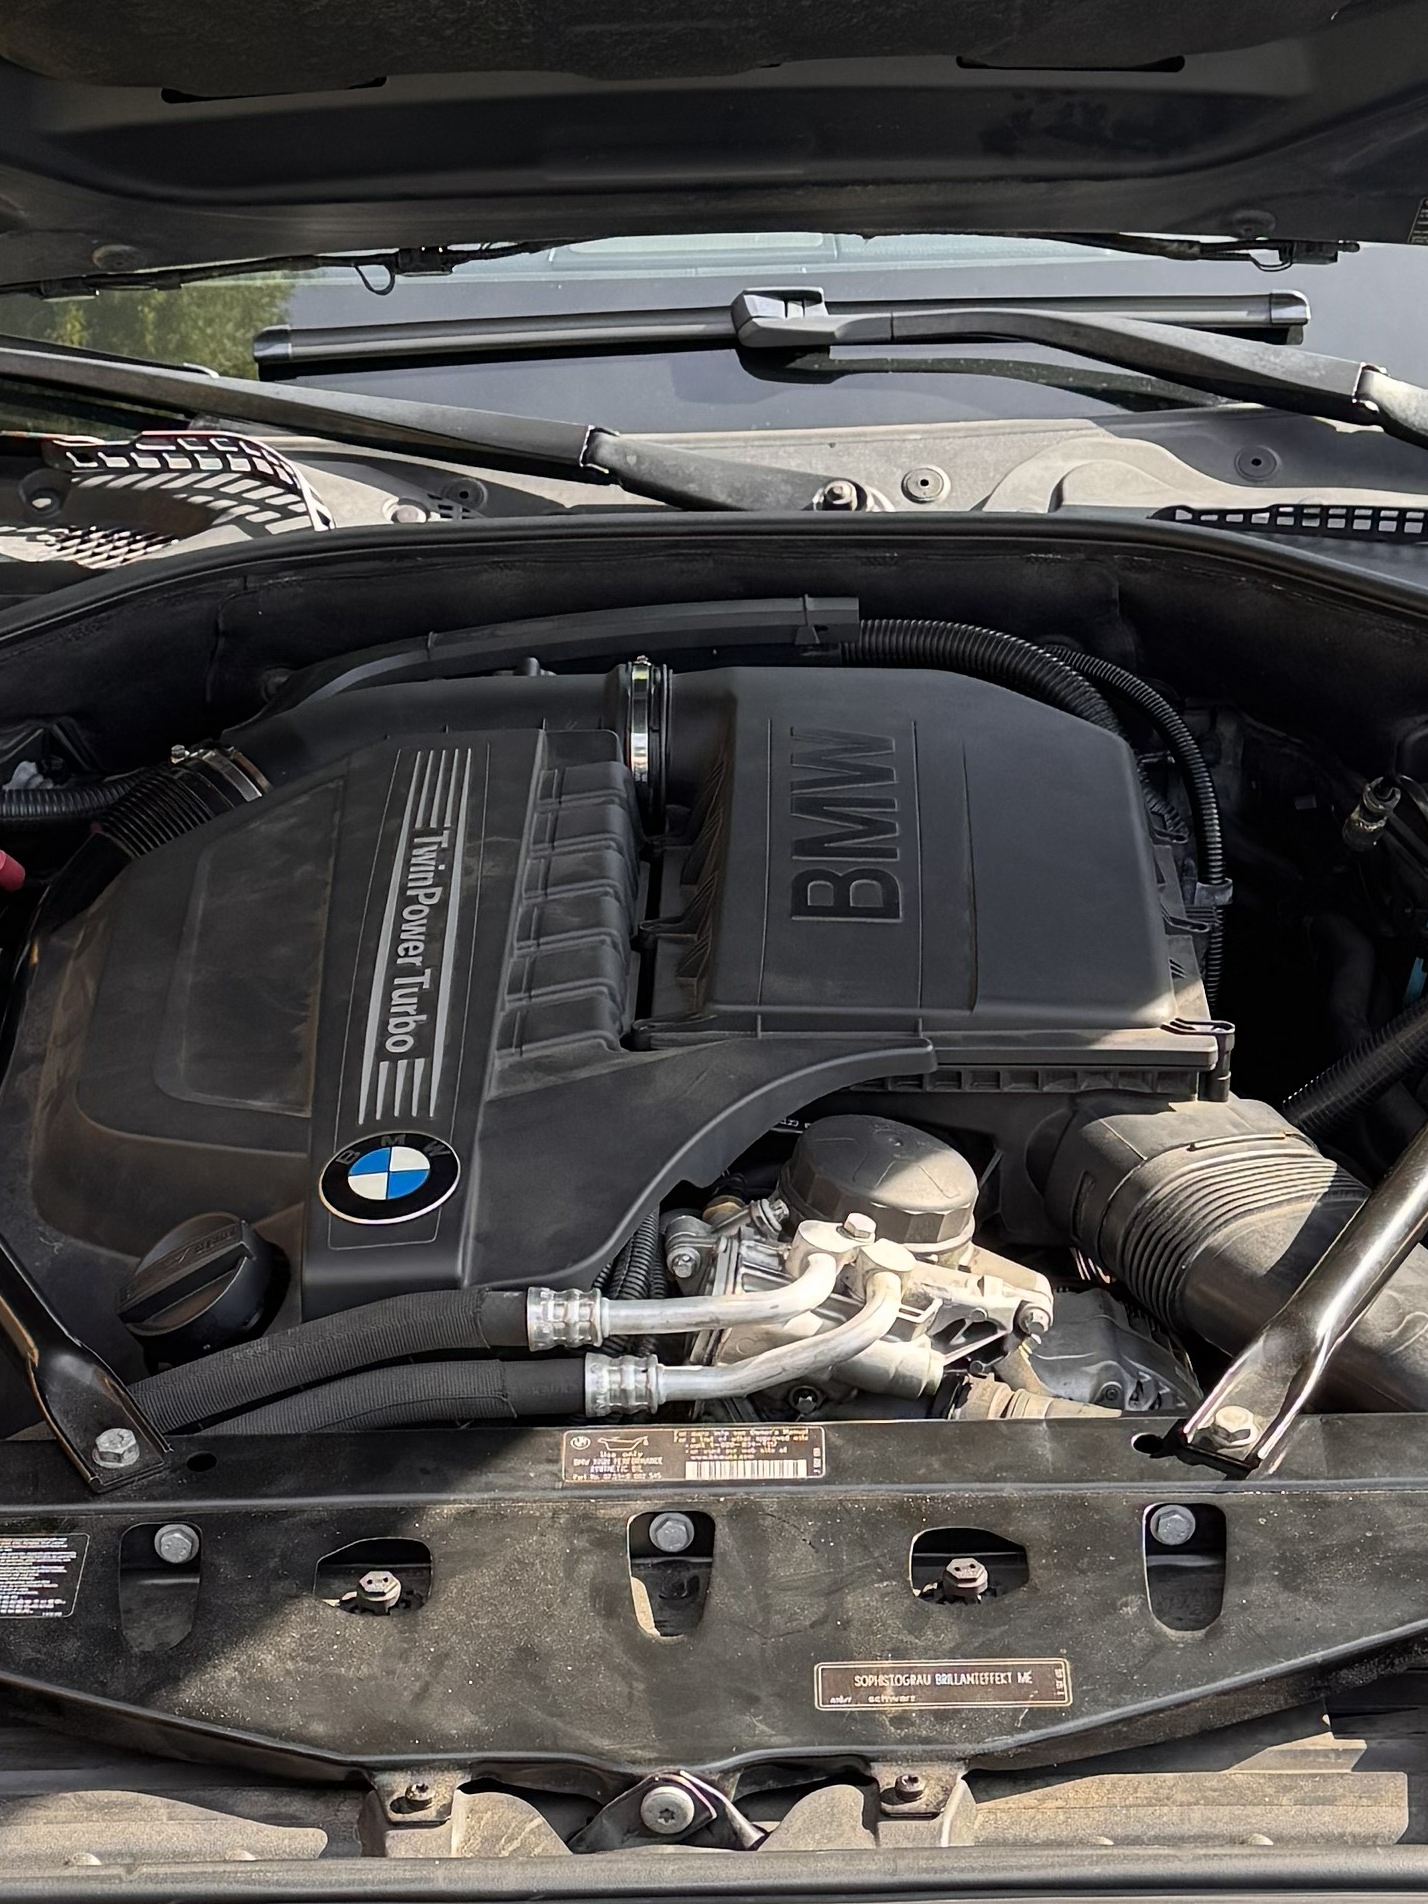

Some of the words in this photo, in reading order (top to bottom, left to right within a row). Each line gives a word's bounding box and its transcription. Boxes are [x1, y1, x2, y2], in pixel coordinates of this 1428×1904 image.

[790, 726, 903, 923] BMW
[395, 828, 450, 968] TwinPower
[385, 967, 432, 1054] Turbo
[334, 1133, 453, 1166] BMW
[854, 1672, 932, 1688] SOPHISTOGRAU
[934, 1671, 1013, 1686] BRILLANTEFFEKT
